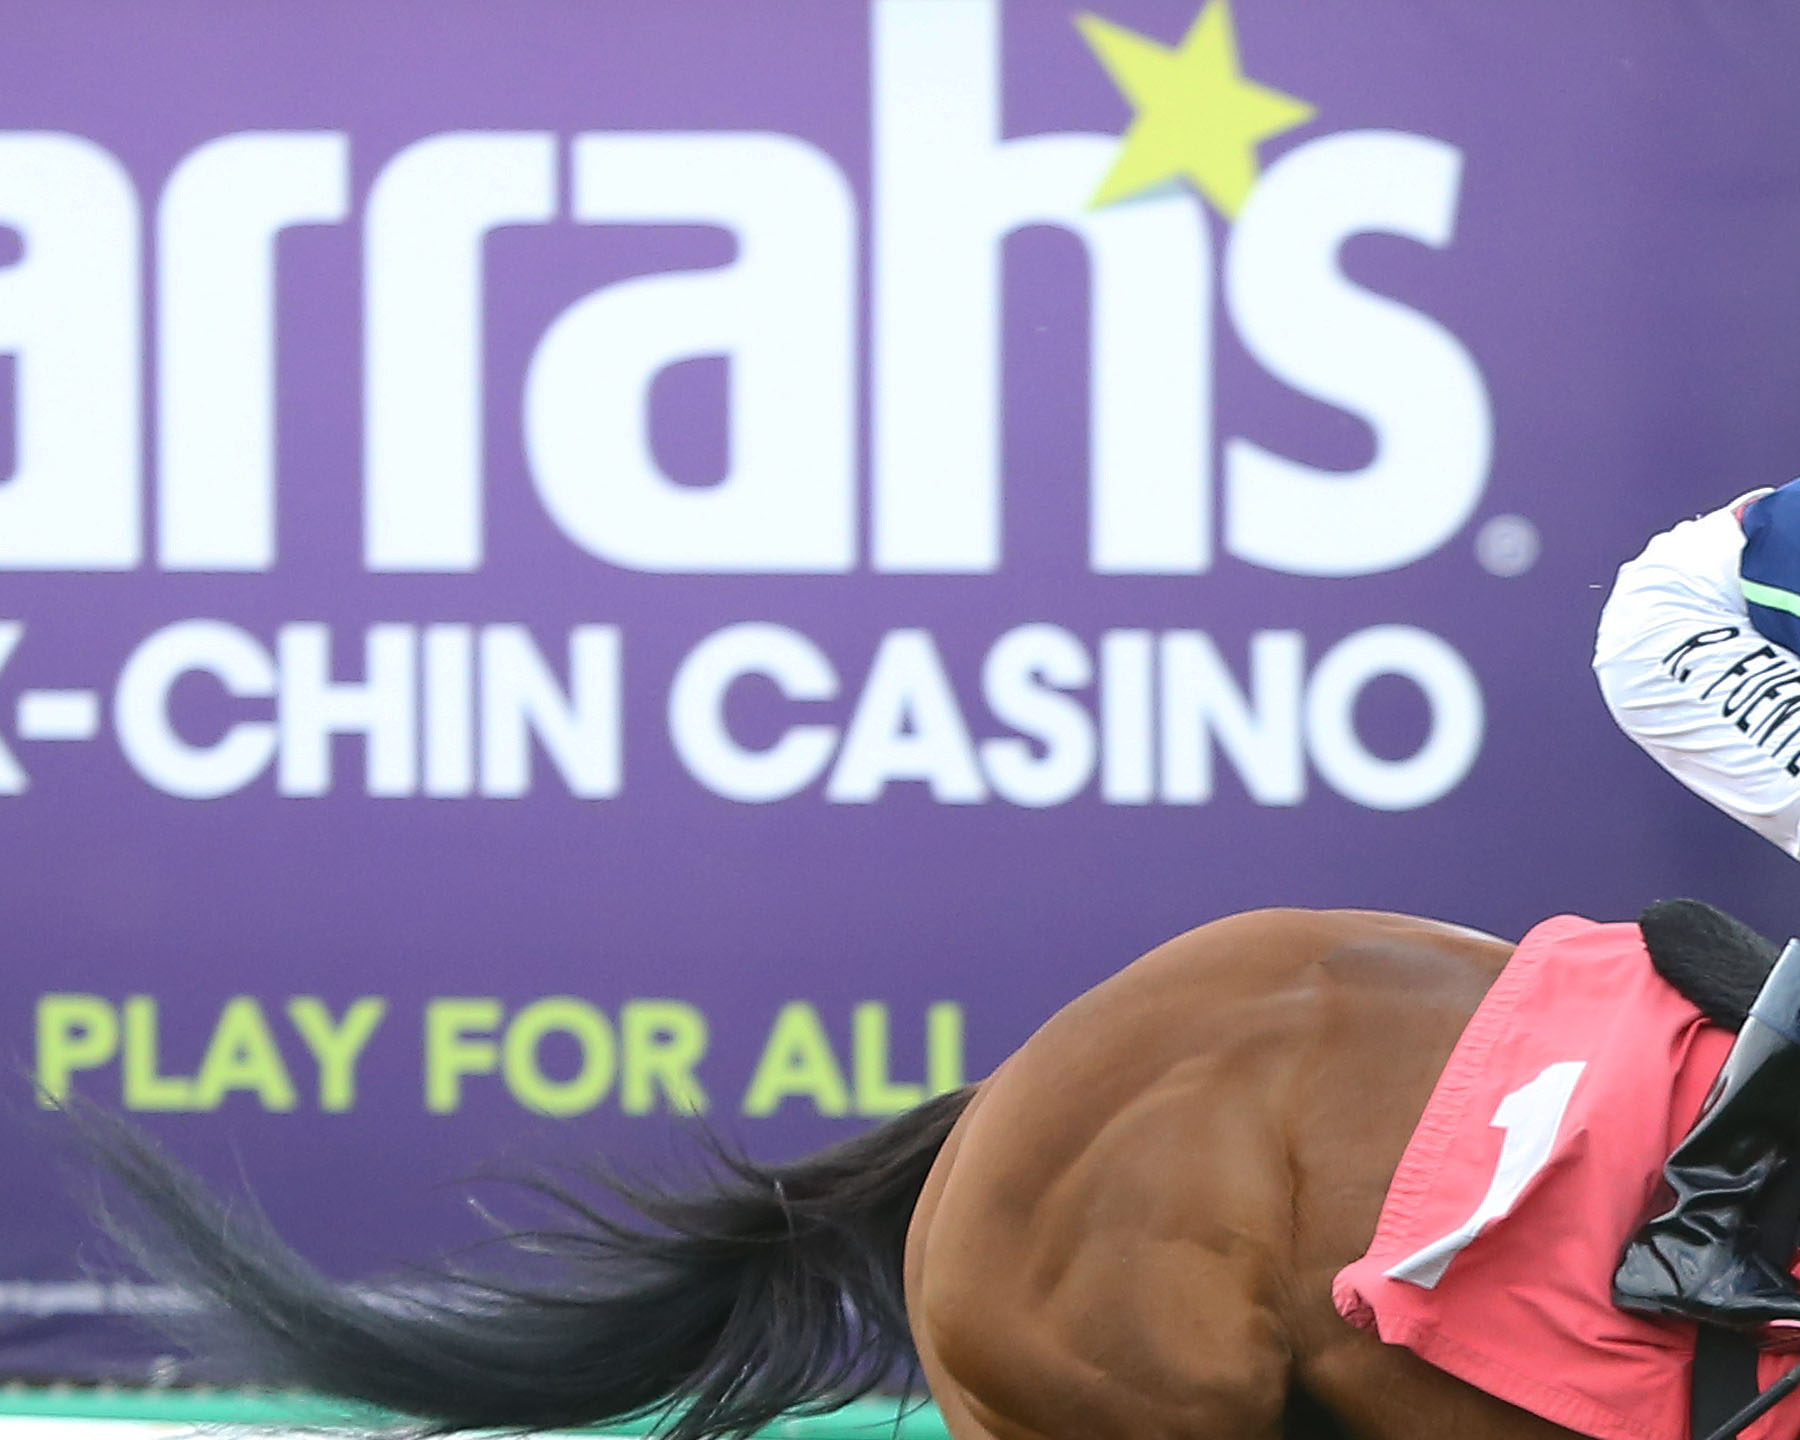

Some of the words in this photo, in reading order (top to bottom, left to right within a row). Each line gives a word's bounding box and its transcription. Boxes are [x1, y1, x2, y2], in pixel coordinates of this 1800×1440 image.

[0, 617, 622, 800] -CHIN
[667, 622, 1485, 810] CASINO
[36, 994, 386, 1112] PLAY
[425, 998, 710, 1117] FOR
[1382, 1061, 1587, 1288] 1
